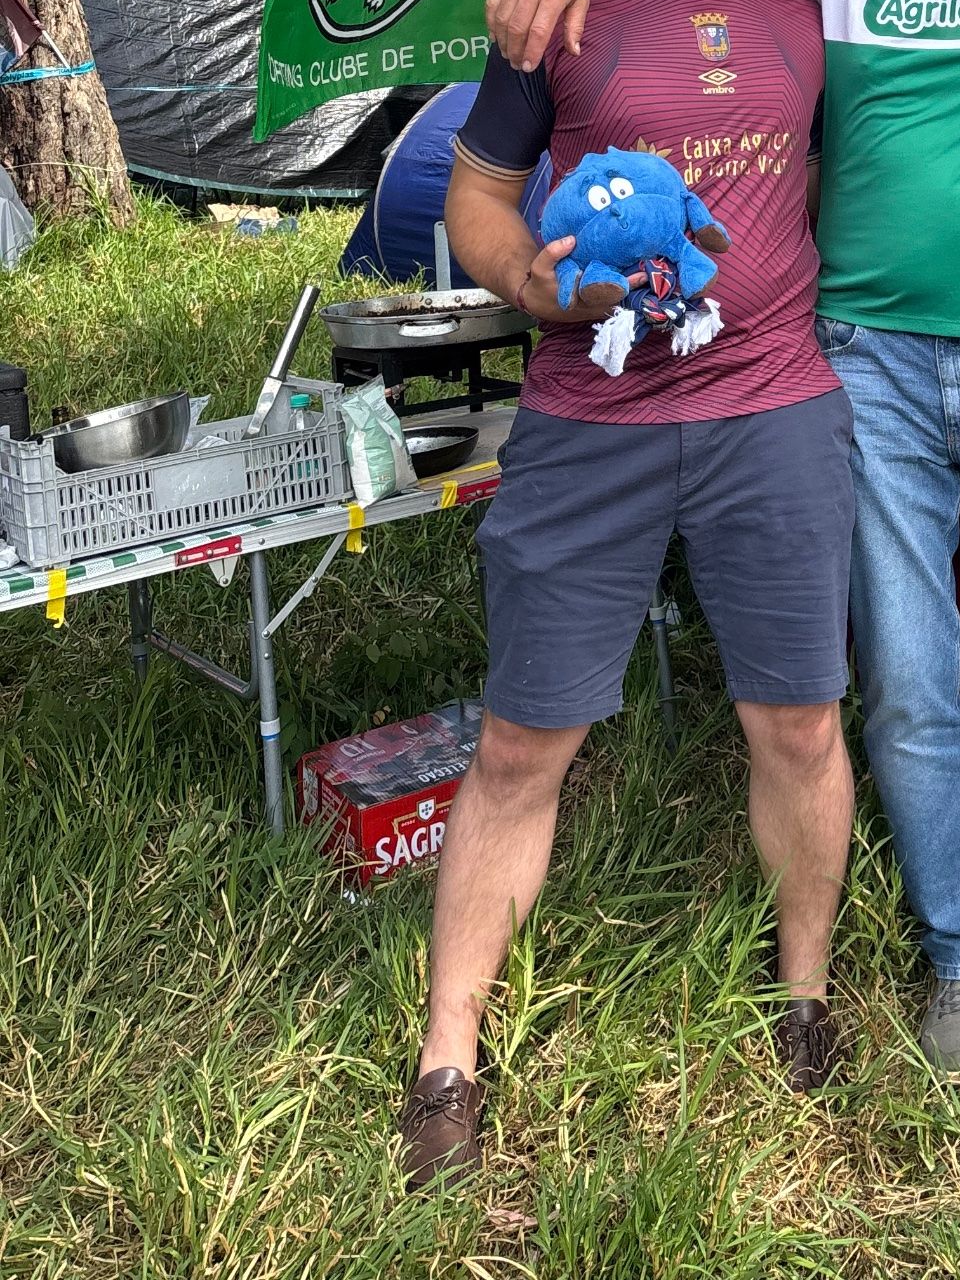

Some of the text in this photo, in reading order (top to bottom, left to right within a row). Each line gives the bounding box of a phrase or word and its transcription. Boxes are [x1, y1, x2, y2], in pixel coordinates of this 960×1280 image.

[268, 35, 490, 88] ORTING CLUBE DE POR
[703, 86, 735, 94] umbro
[682, 134, 731, 160] Caixa
[684, 161, 702, 186] de
[374, 821, 446, 875] SAGR
